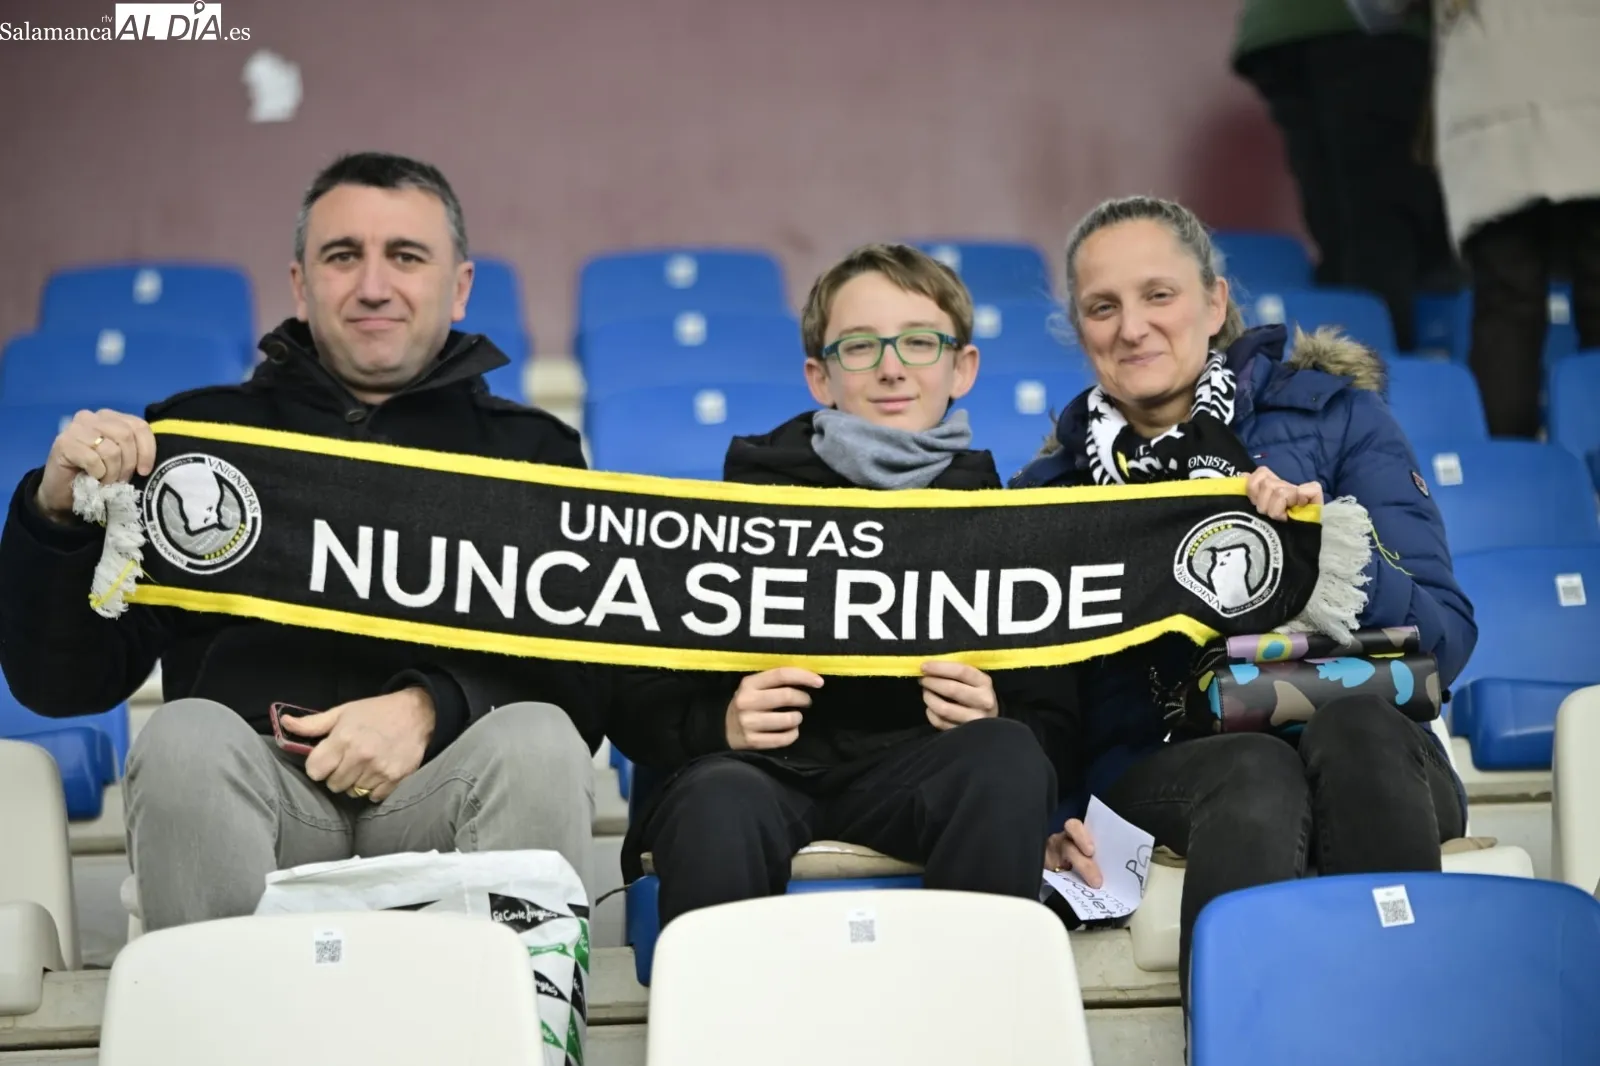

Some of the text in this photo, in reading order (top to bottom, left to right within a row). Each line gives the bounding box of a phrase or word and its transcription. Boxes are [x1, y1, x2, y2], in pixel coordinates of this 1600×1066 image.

[560, 501, 884, 559] UNIONISTAS
[309, 518, 661, 632] NUNCA
[680, 562, 808, 639] SE
[834, 562, 1125, 641] RINDE
